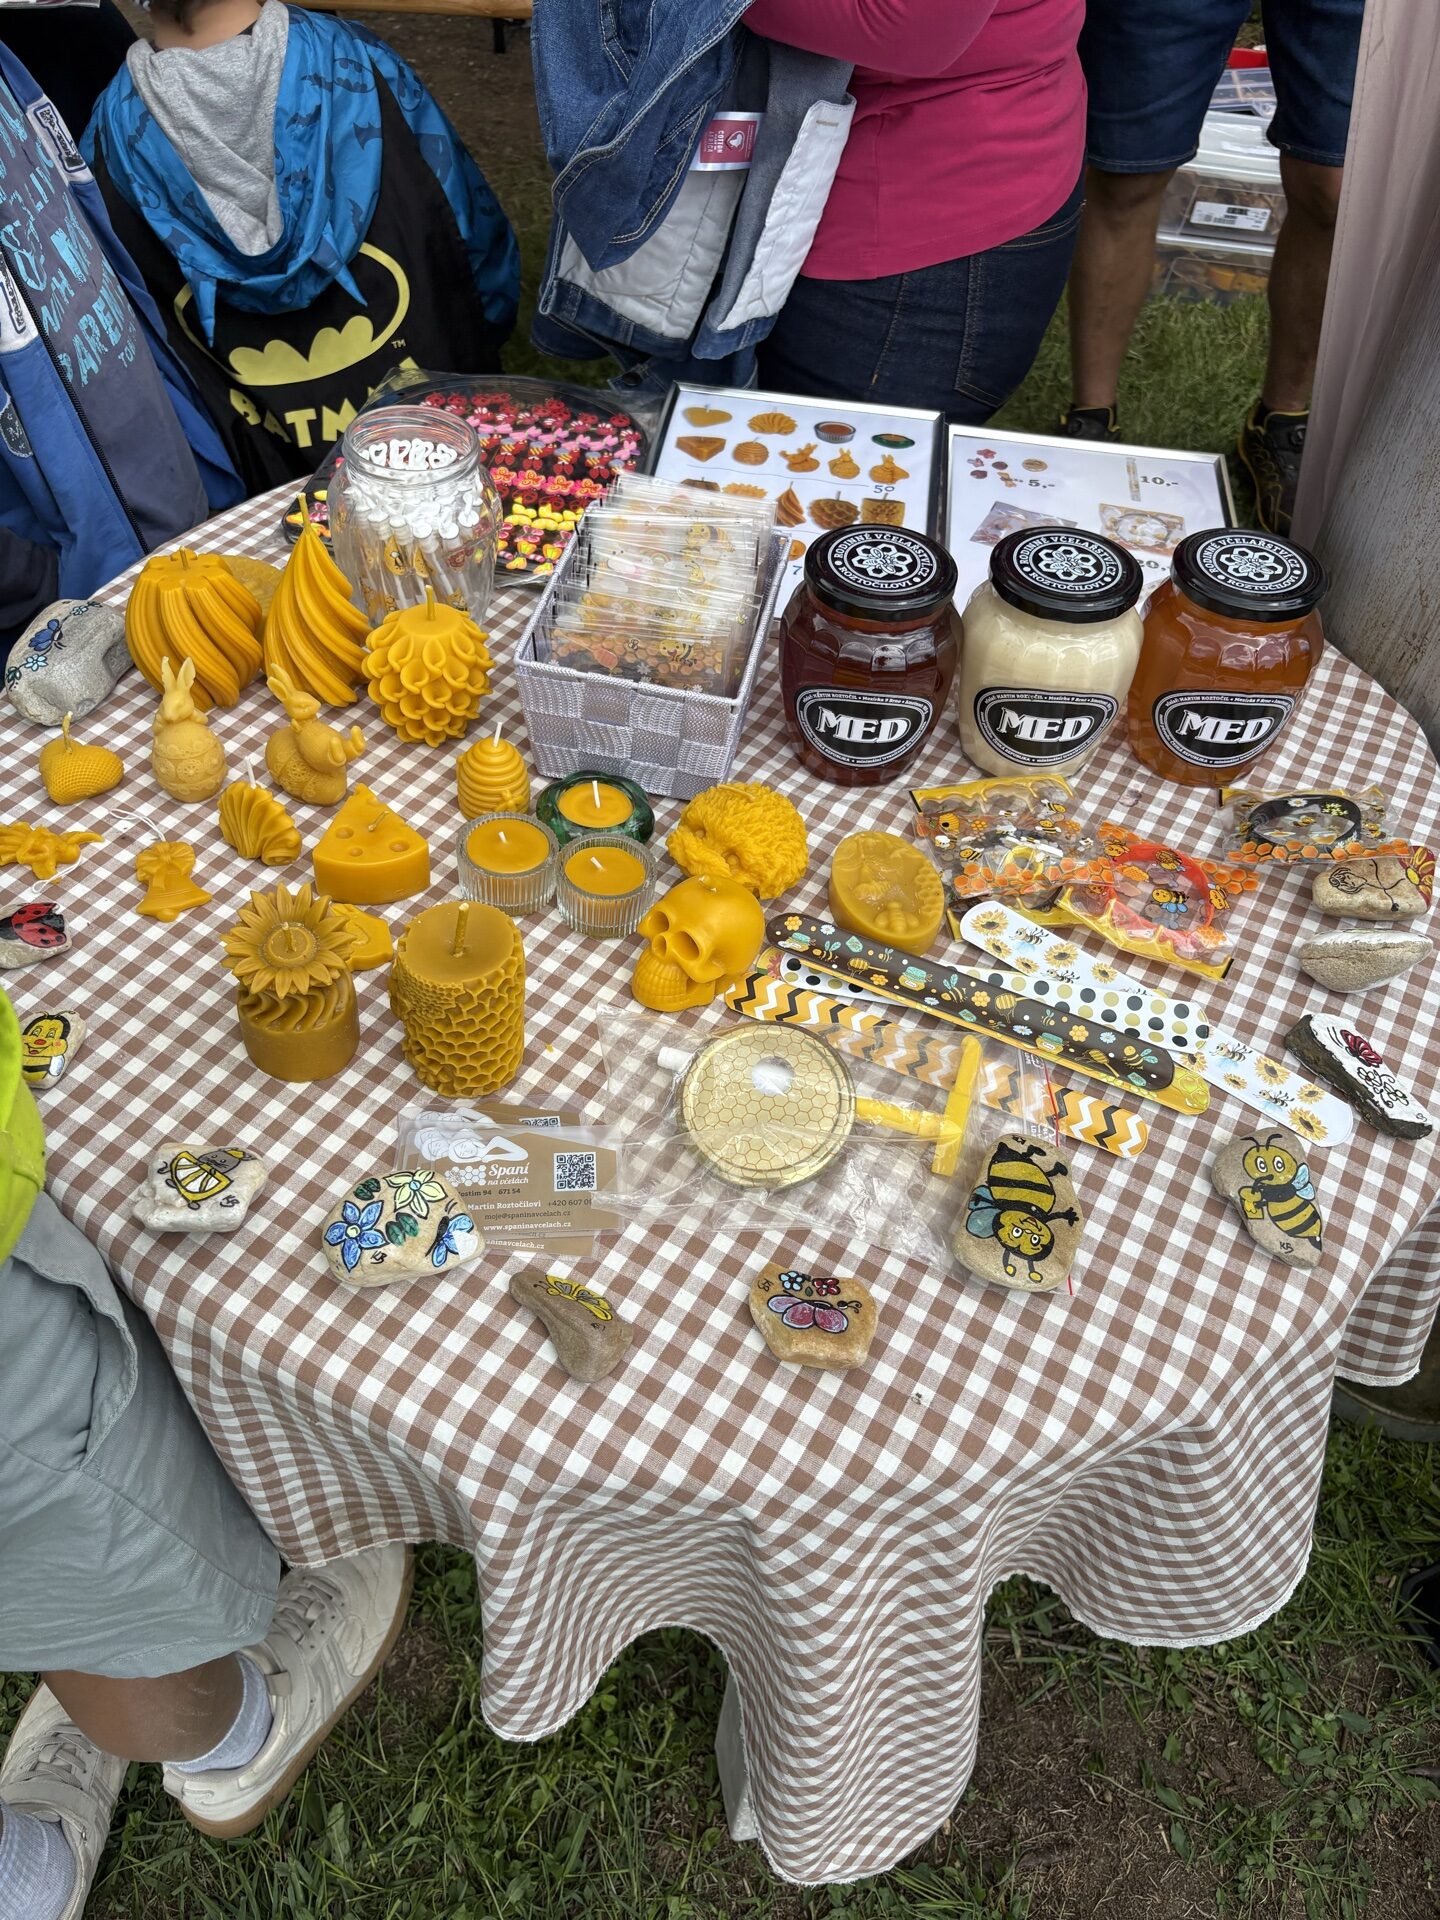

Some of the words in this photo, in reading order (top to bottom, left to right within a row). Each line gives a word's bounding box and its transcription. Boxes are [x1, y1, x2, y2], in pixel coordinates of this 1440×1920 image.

[391, 339, 406, 348] TM
[873, 485, 895, 494] 50
[834, 533, 872, 560] RODINNÉ
[1020, 537, 1050, 565] RODINNÉ
[1203, 542, 1221, 573] RODINNÉ
[839, 565, 912, 589] ROZTOČILOVI
[1029, 572, 1105, 591] ROZTOČILOVI
[1227, 574, 1299, 591] ROZTOČILOVI
[832, 692, 857, 700] ROZTOČIL
[815, 706, 912, 744] MED
[996, 707, 1095, 743] MED
[1175, 709, 1275, 744] MED
[489, 1162, 530, 1179] Spaní
[500, 1177, 529, 1185] včelách
[468, 1202, 495, 1211] Martin
[497, 1199, 541, 1209] Roztočilovi
[485, 1210, 571, 1221] moje@spaninavcelach.cz
[483, 1222, 572, 1231] www.spaninavcelach.cz
[486, 1240, 545, 1250] aninavcelach.cz
